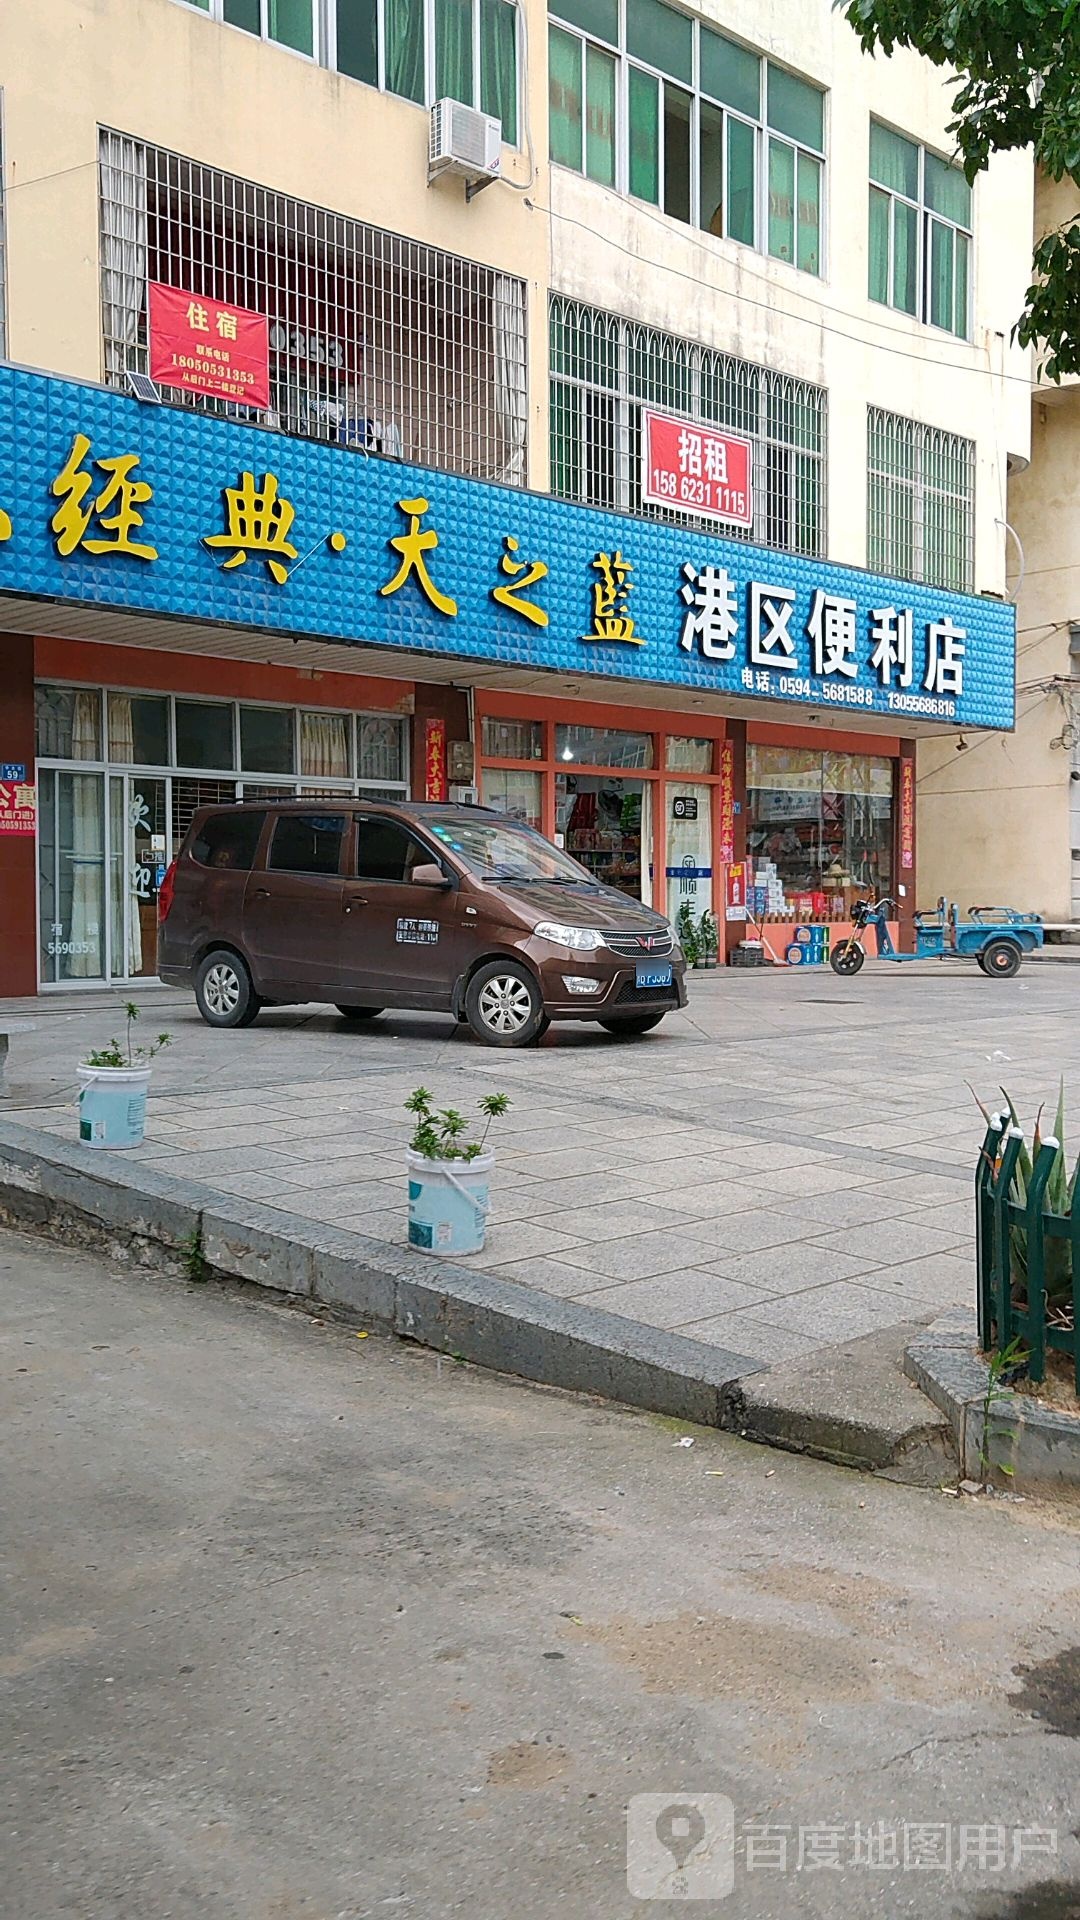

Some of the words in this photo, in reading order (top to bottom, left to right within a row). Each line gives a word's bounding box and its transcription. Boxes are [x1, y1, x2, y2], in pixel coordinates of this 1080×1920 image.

[186, 301, 238, 341] 住宿
[171, 353, 255, 385] 18050531353
[196, 344, 230, 363] 联系电话
[678, 428, 728, 484] 招租
[654, 469, 677, 496] 158
[681, 476, 711, 506] 6231
[716, 486, 745, 514] 1115
[681, 562, 967, 695] 港区便利店
[887, 692, 956, 717] 13055686816
[7, 770, 19, 779] 59
[48, 942, 96, 955] 5690353
